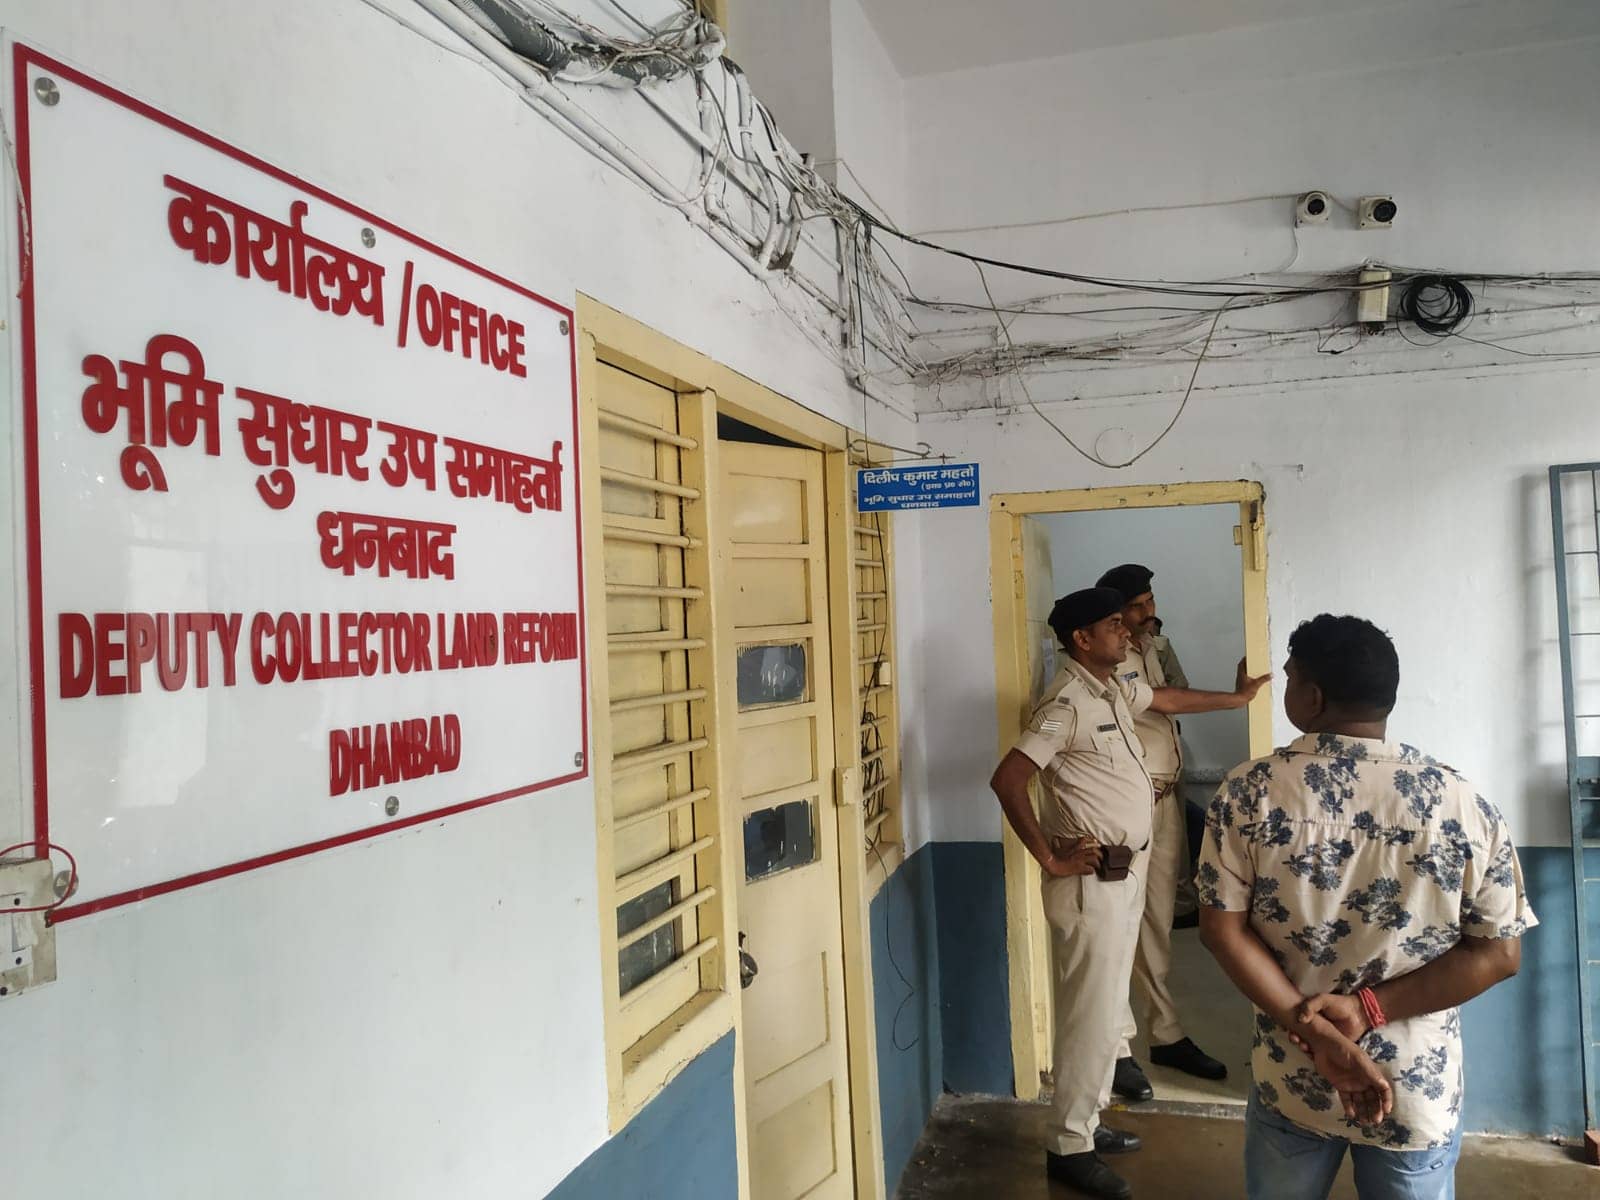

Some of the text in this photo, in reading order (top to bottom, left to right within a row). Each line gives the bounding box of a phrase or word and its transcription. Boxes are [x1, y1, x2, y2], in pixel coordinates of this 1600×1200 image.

[164, 174, 386, 327] कार्यालय
[81, 333, 564, 513] भूमि सुधार उप समाहर्ता
[864, 465, 975, 486] दिलीप कुमार महतो
[316, 511, 458, 581] धनबाद
[59, 612, 579, 699] DEPUTY COLLECTOR LAND REFORM
[329, 713, 462, 797] DHANBAD
